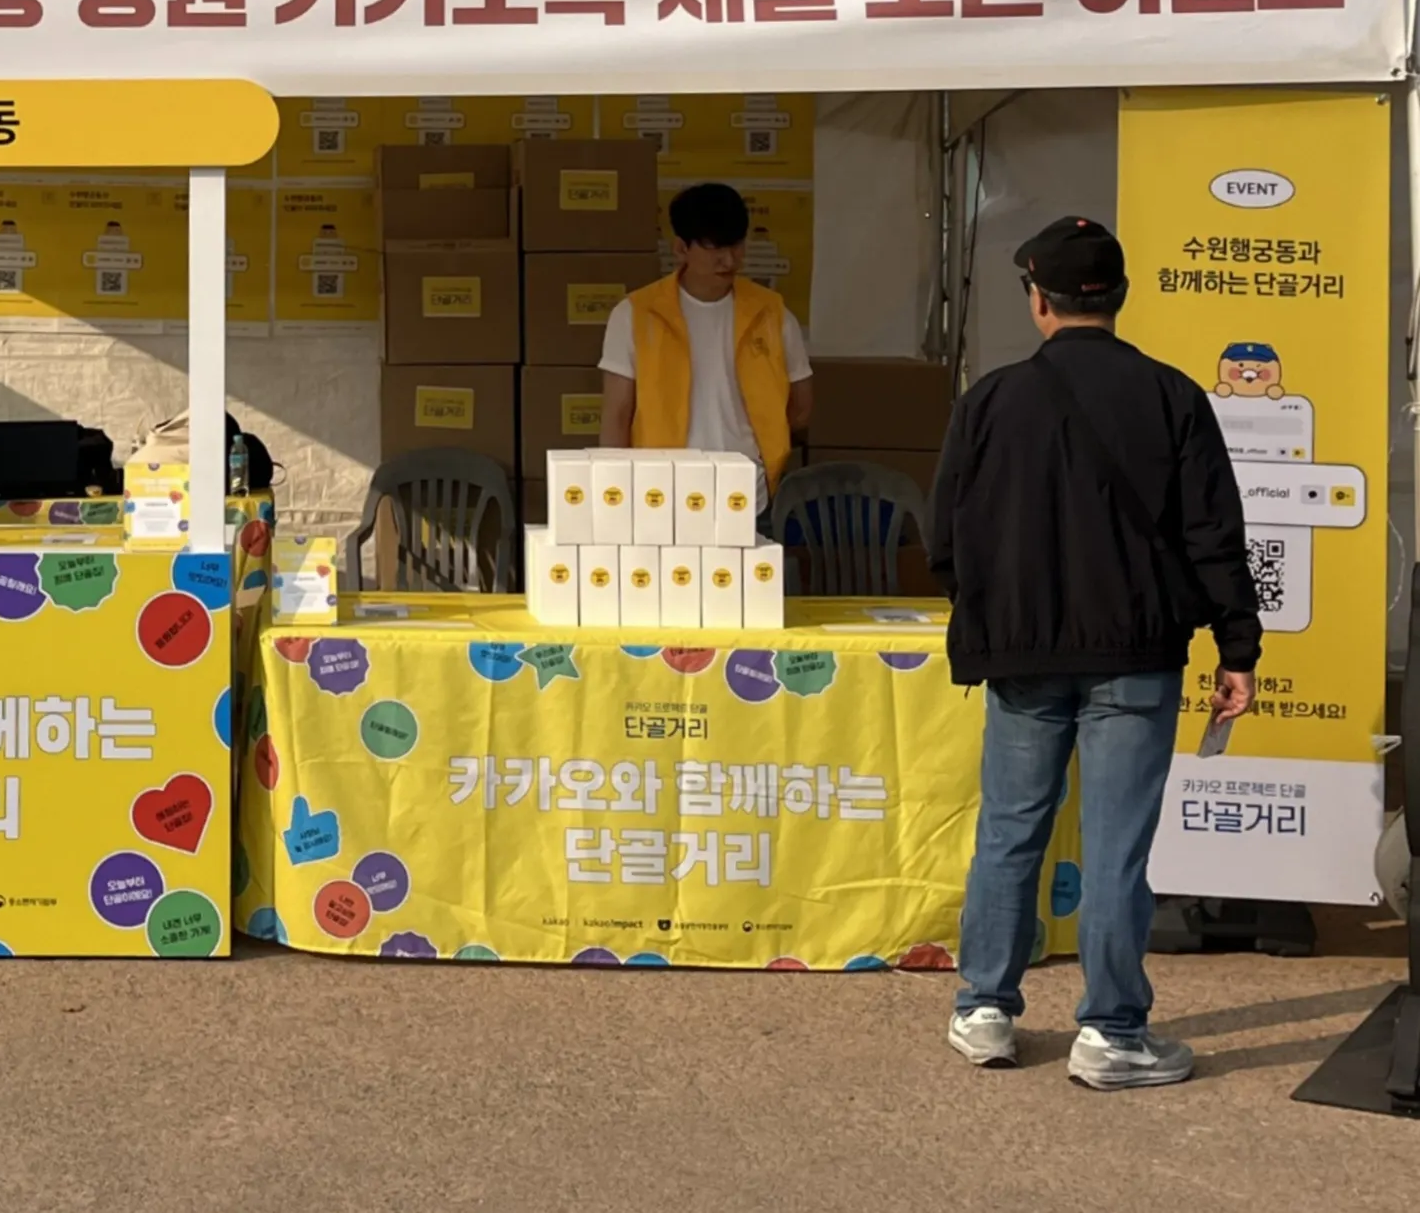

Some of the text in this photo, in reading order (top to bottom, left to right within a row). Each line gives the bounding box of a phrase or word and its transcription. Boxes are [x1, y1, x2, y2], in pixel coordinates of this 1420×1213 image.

[1226, 181, 1279, 197] EVENT
[1182, 237, 1322, 265] 수원행궁동과
[1157, 268, 1345, 299] 함께하는 단골거리
[1279, 701, 1348, 720] 받으세요!
[624, 715, 709, 740] 단골거리
[447, 755, 888, 822] 카카오와 함께하는
[1182, 779, 1306, 799] 카카오 프로젝트 단골
[1182, 800, 1307, 836] 단골거리
[564, 827, 774, 888] 단골거리
[107, 875, 146, 892] 오늘부터
